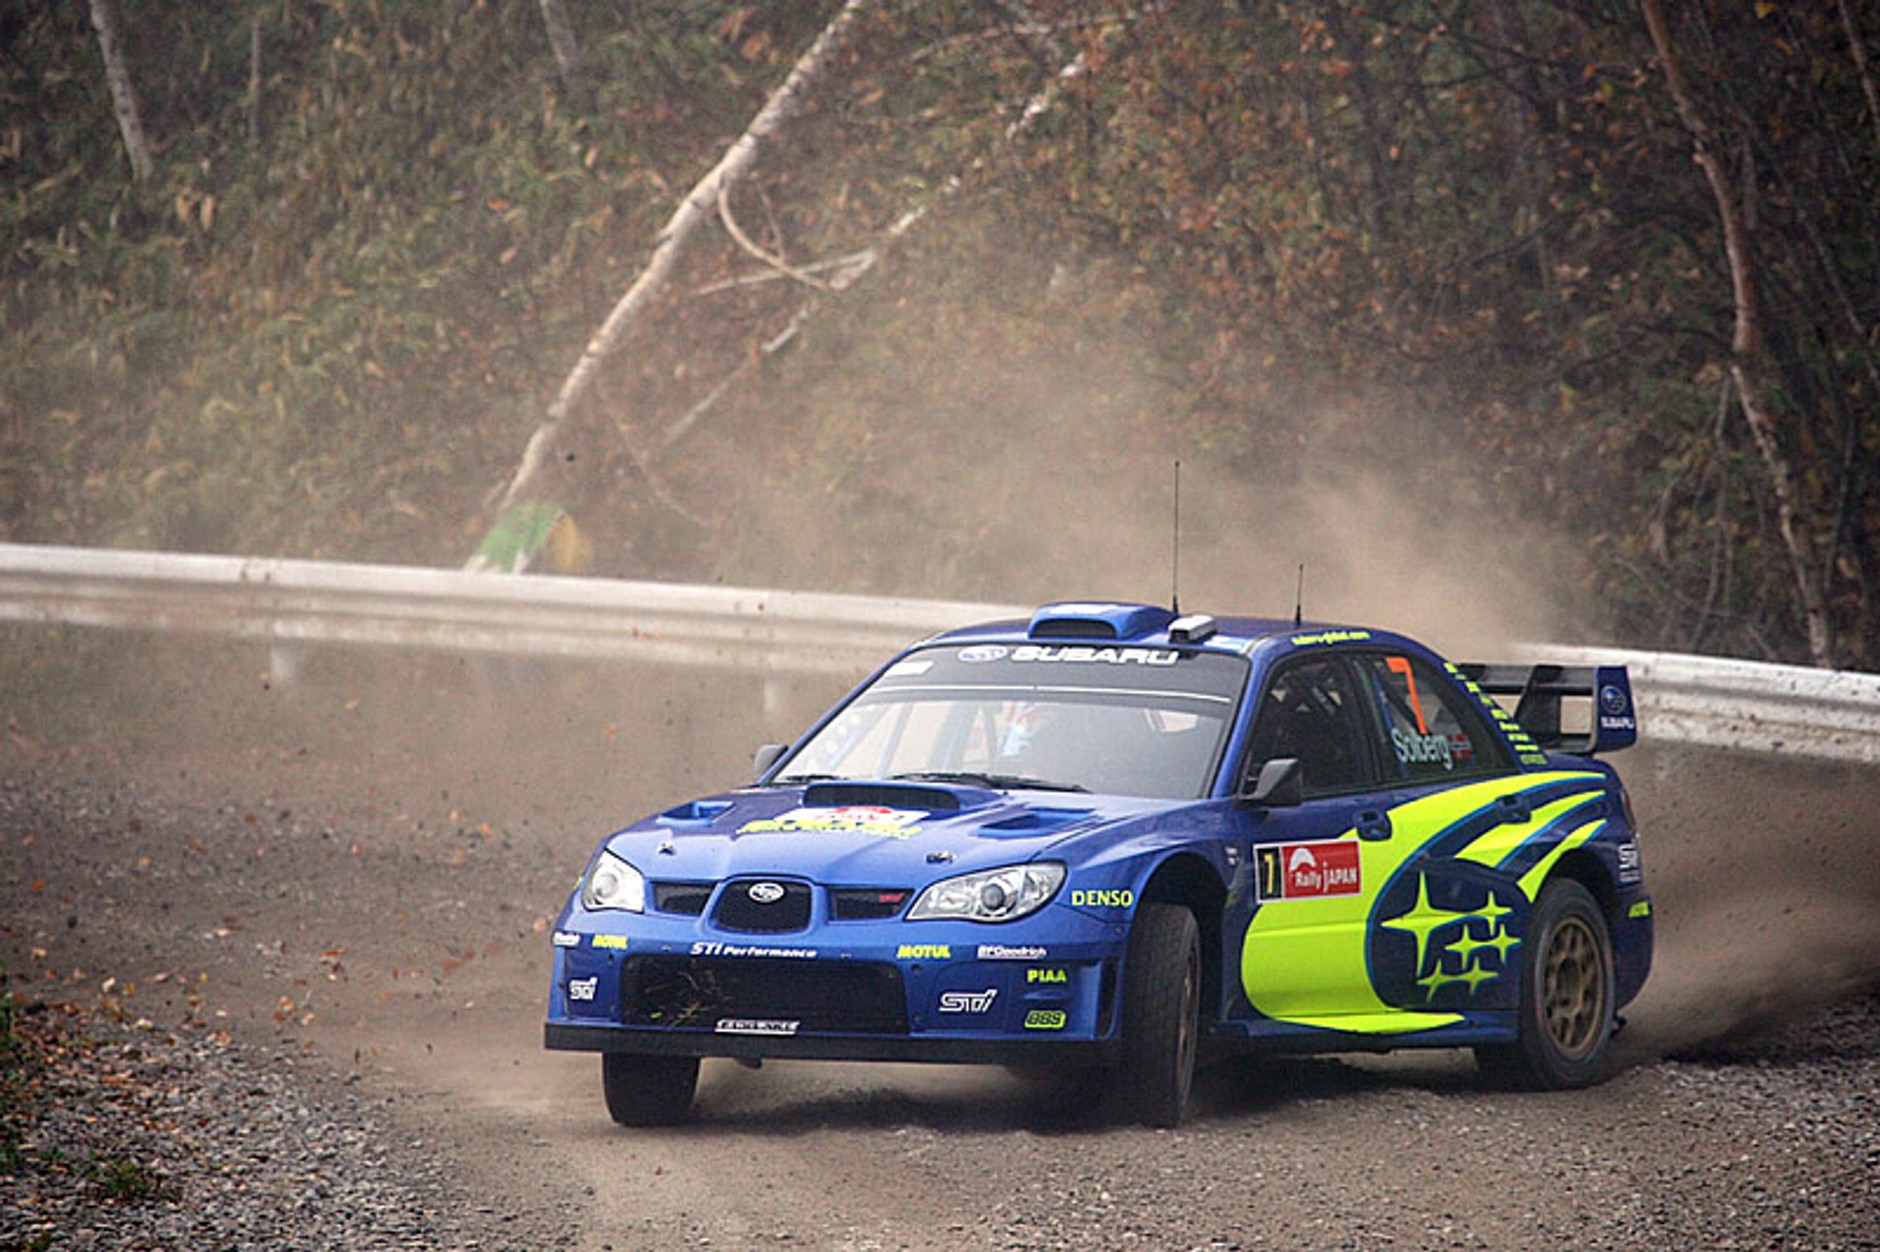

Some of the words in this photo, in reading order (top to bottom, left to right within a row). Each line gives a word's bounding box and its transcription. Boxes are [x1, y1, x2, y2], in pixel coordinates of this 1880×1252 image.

[1010, 646, 1180, 665] SUBARU
[1071, 889, 1134, 907] DENSO
[896, 944, 952, 959] MOTUL
[1027, 968, 1067, 983] PIAA
